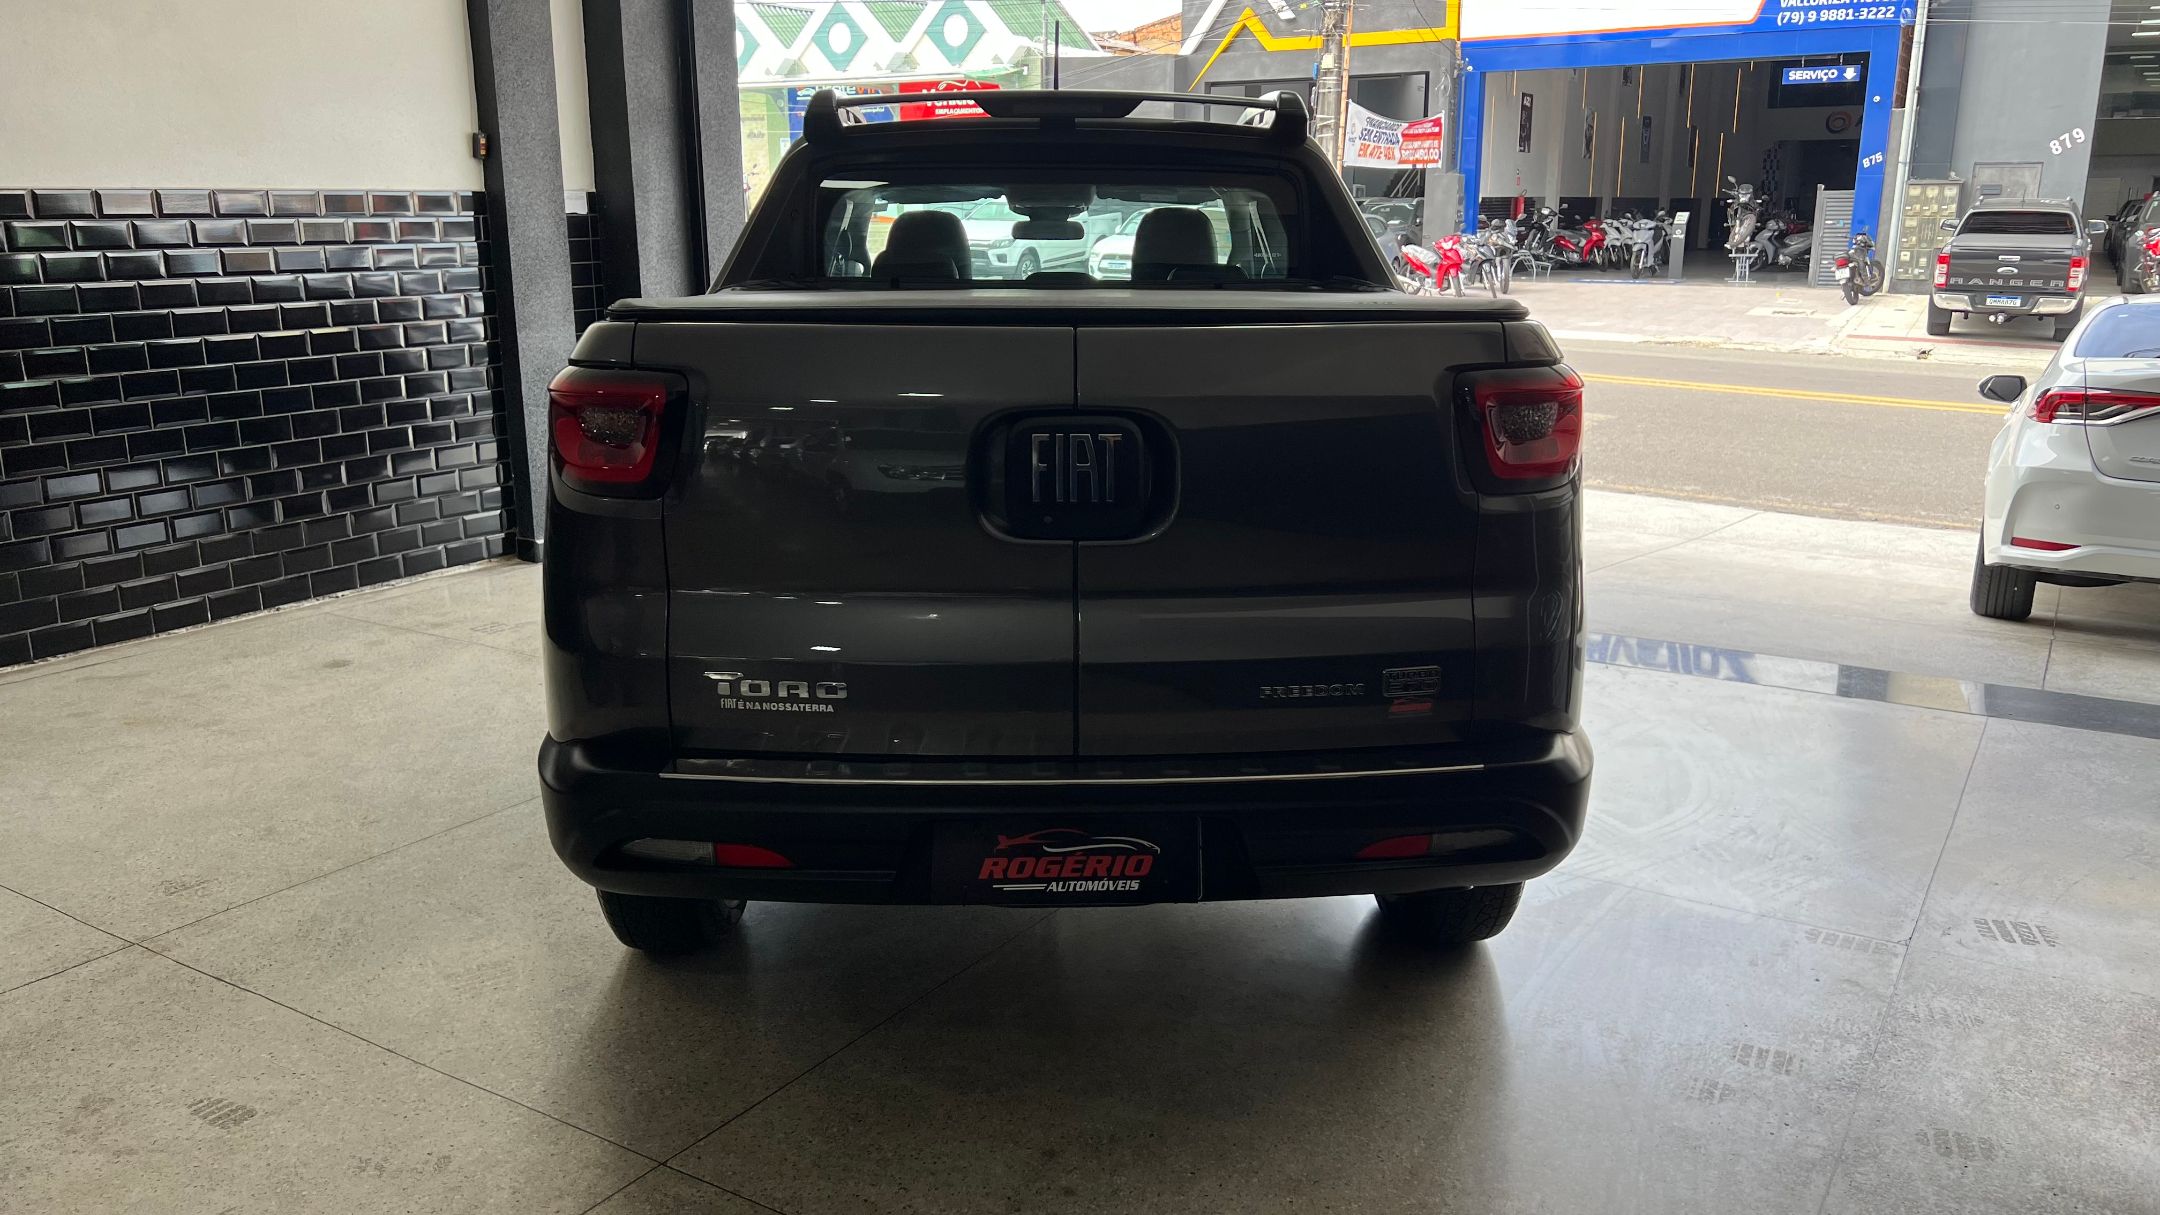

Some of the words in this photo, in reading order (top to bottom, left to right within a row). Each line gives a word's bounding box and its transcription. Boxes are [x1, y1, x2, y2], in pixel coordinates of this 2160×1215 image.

[1777, 11, 1804, 26] (79)
[1807, 10, 1817, 22] 9
[1820, 5, 1895, 21] 9881-3222
[1788, 69, 1838, 82] SERVIÇO
[2049, 127, 2086, 155] 879
[1862, 152, 1883, 168] 875
[1949, 277, 2064, 287] RANGER
[1032, 433, 1123, 503] FIAT
[703, 671, 848, 699] TORO
[1258, 683, 1366, 698] FREEDOM
[720, 698, 737, 709] FIAT
[738, 699, 745, 709] É
[746, 701, 761, 710] NA
[978, 851, 1153, 880] ROGÉRIO
[1047, 877, 1141, 892] AUTOMÓVEIS
